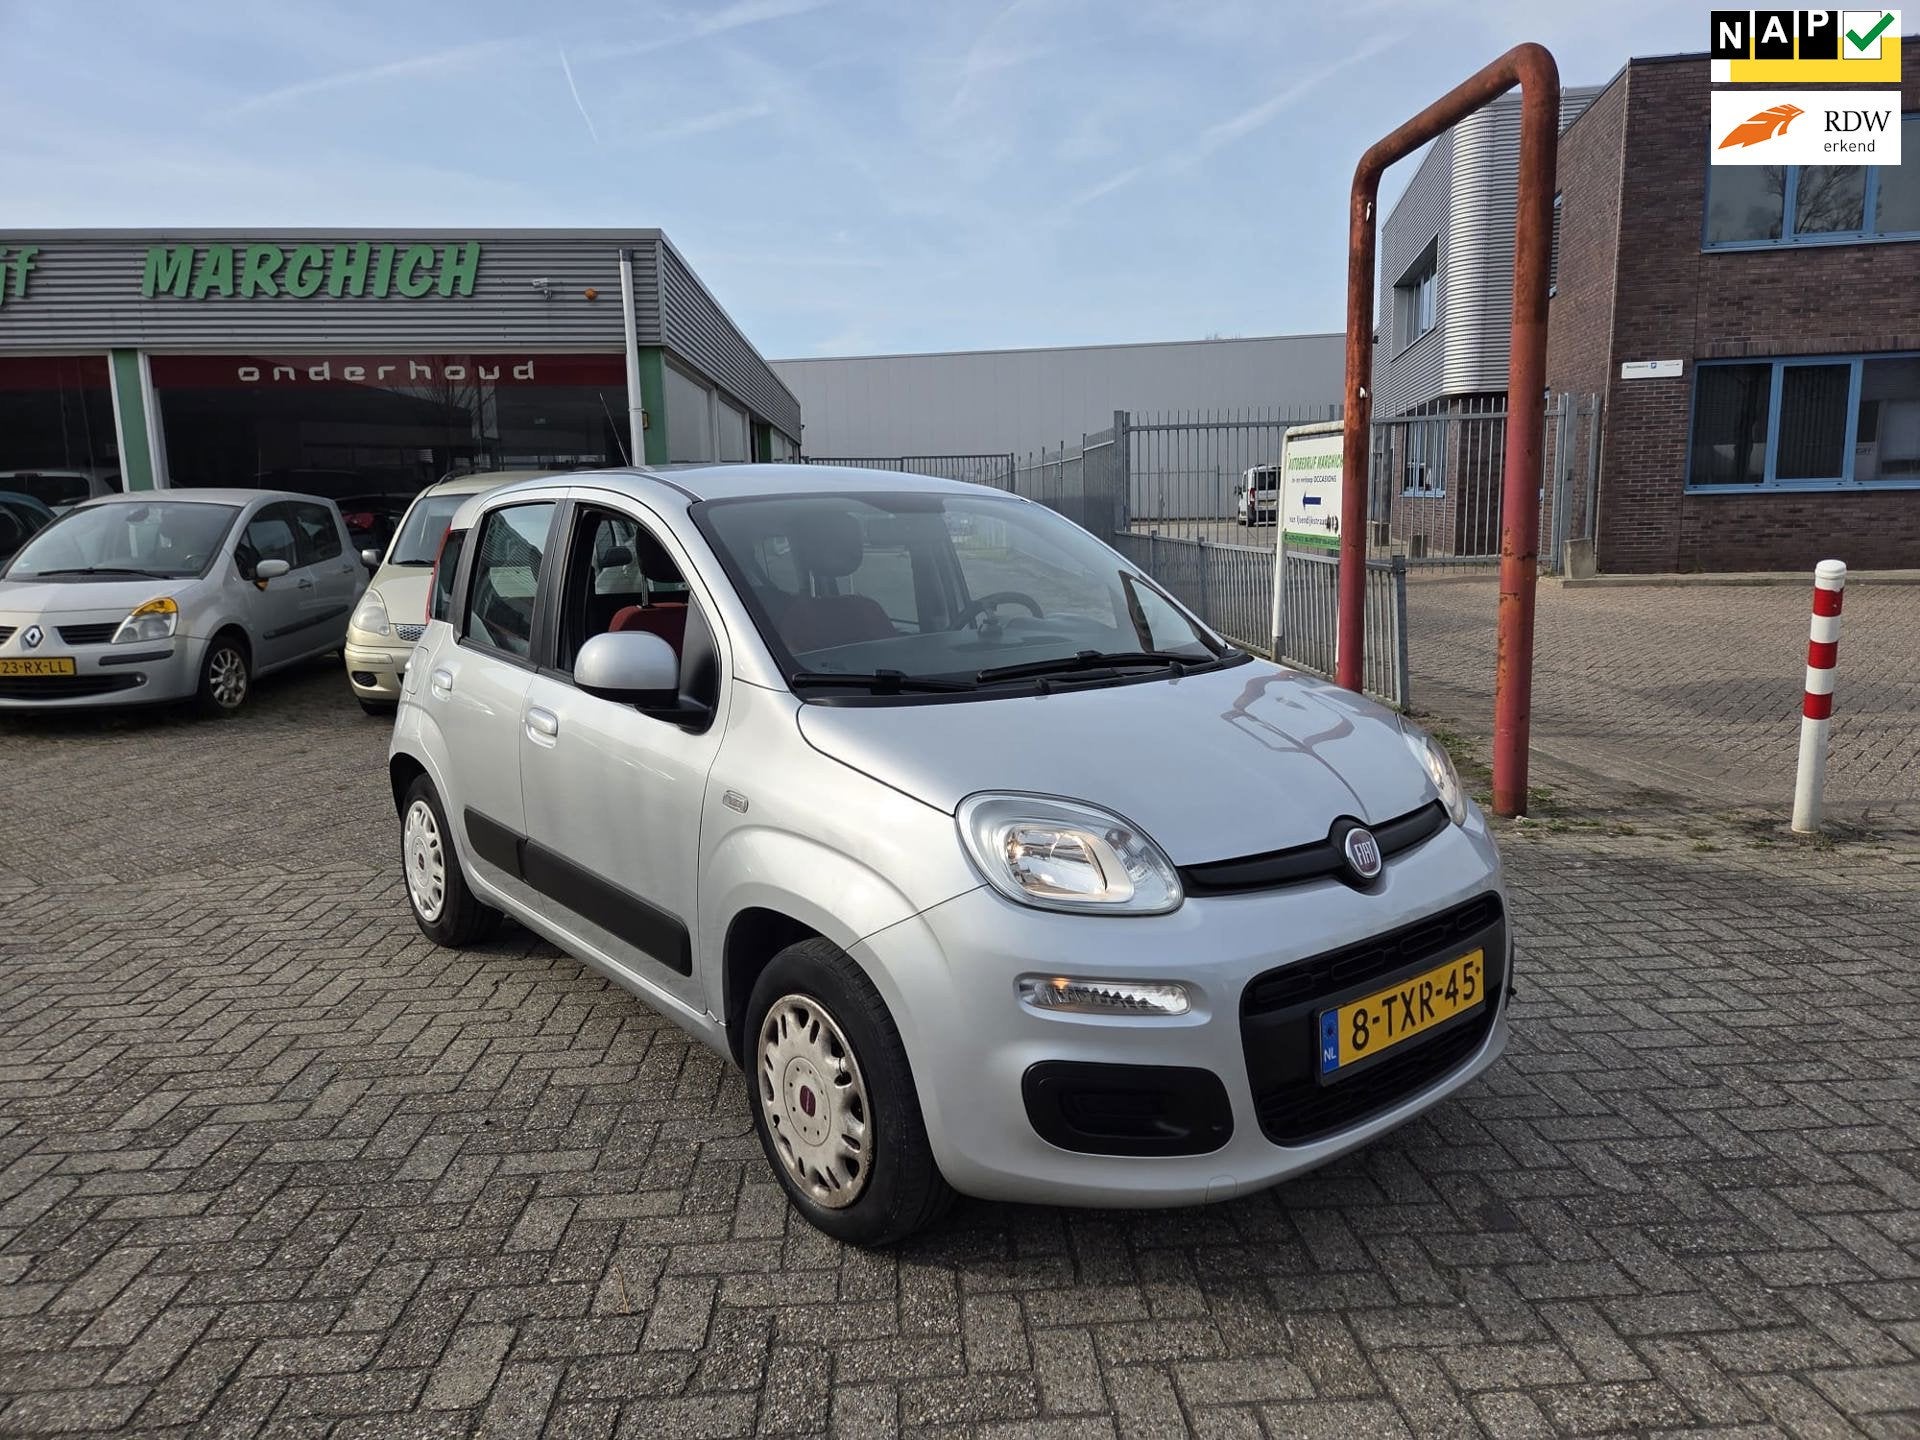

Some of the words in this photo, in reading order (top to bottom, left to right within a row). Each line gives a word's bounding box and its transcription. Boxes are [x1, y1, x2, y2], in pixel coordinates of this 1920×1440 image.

[141, 241, 481, 299] MARGHICH
[238, 360, 535, 382] onderhoud
[1313, 474, 1337, 483] OCCASIONS
[2, 661, 67, 674] 23-RX-LL
[1354, 841, 1376, 866] FIAT
[1351, 960, 1476, 1051] 8-TXR-45
[1323, 1047, 1337, 1061] NL
